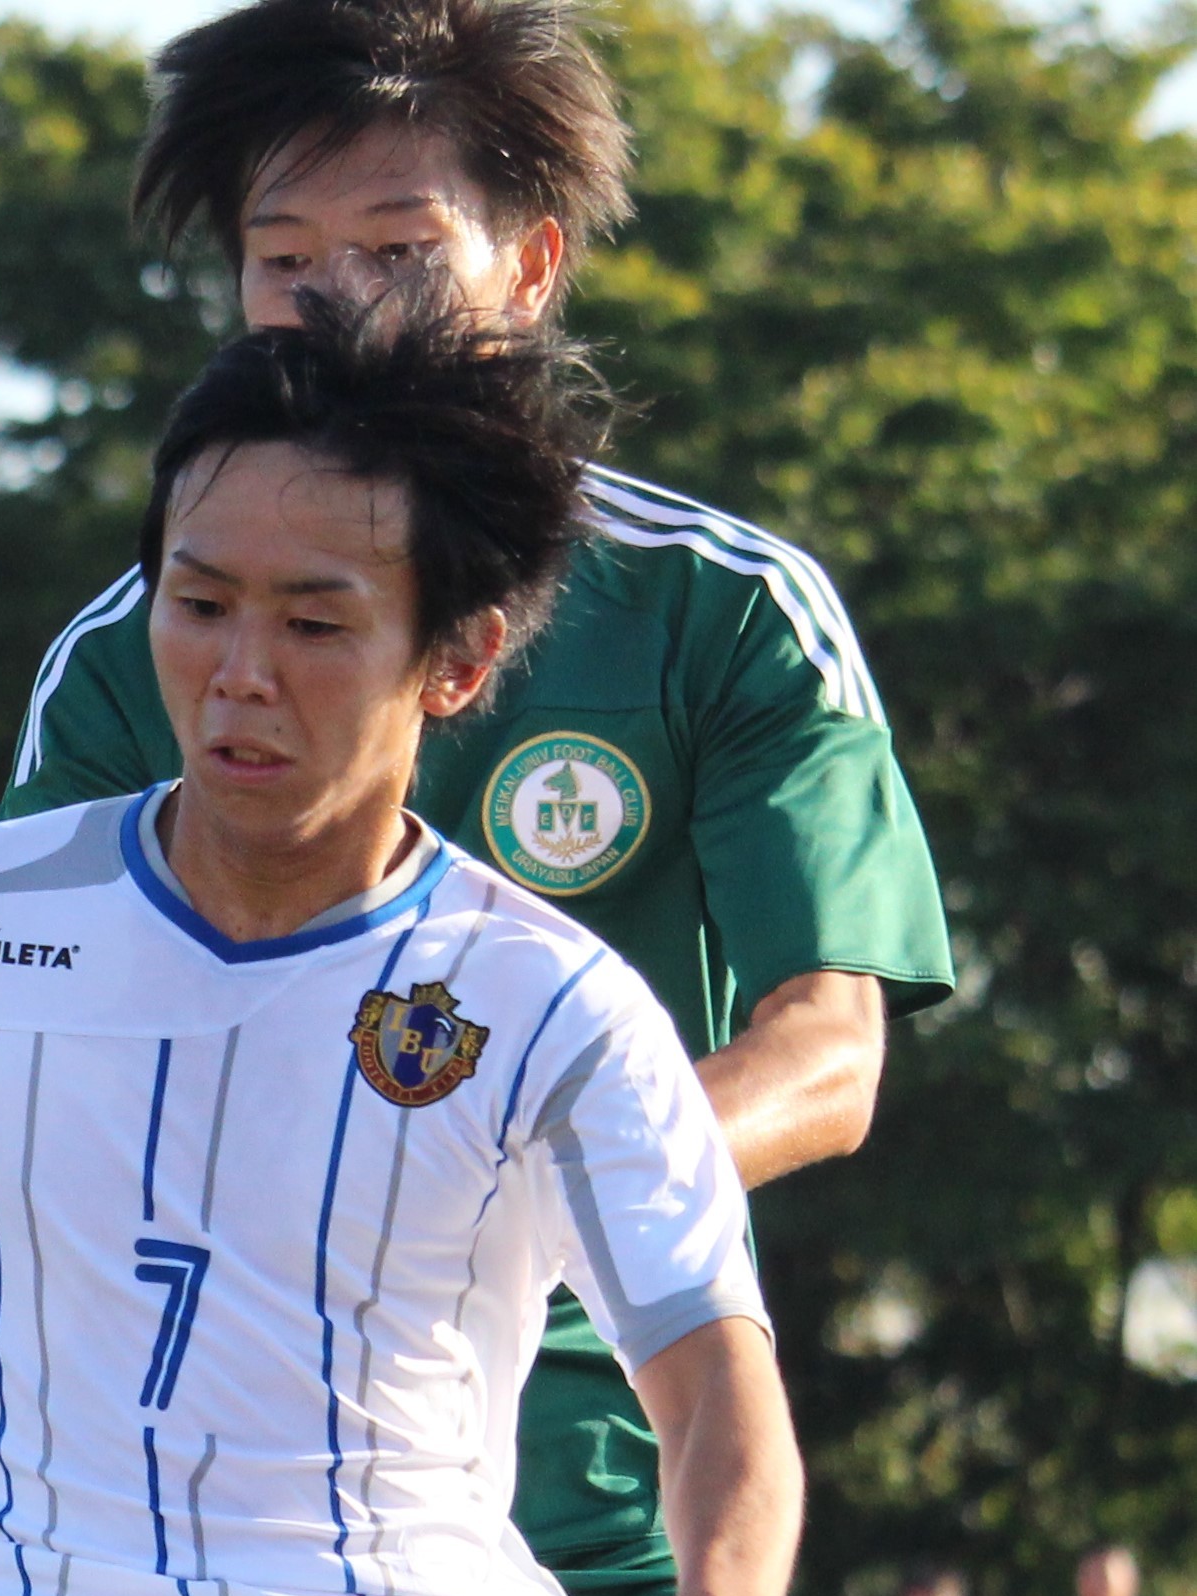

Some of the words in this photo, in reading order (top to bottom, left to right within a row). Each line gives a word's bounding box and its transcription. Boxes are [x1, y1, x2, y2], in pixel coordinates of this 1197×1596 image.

[553, 744, 596, 762] FOOT
[595, 755, 627, 789] BALL
[622, 789, 639, 827] CLUB
[511, 848, 575, 884] URAYASU
[578, 847, 620, 881] JAPAN
[134, 1238, 211, 1411] 7
